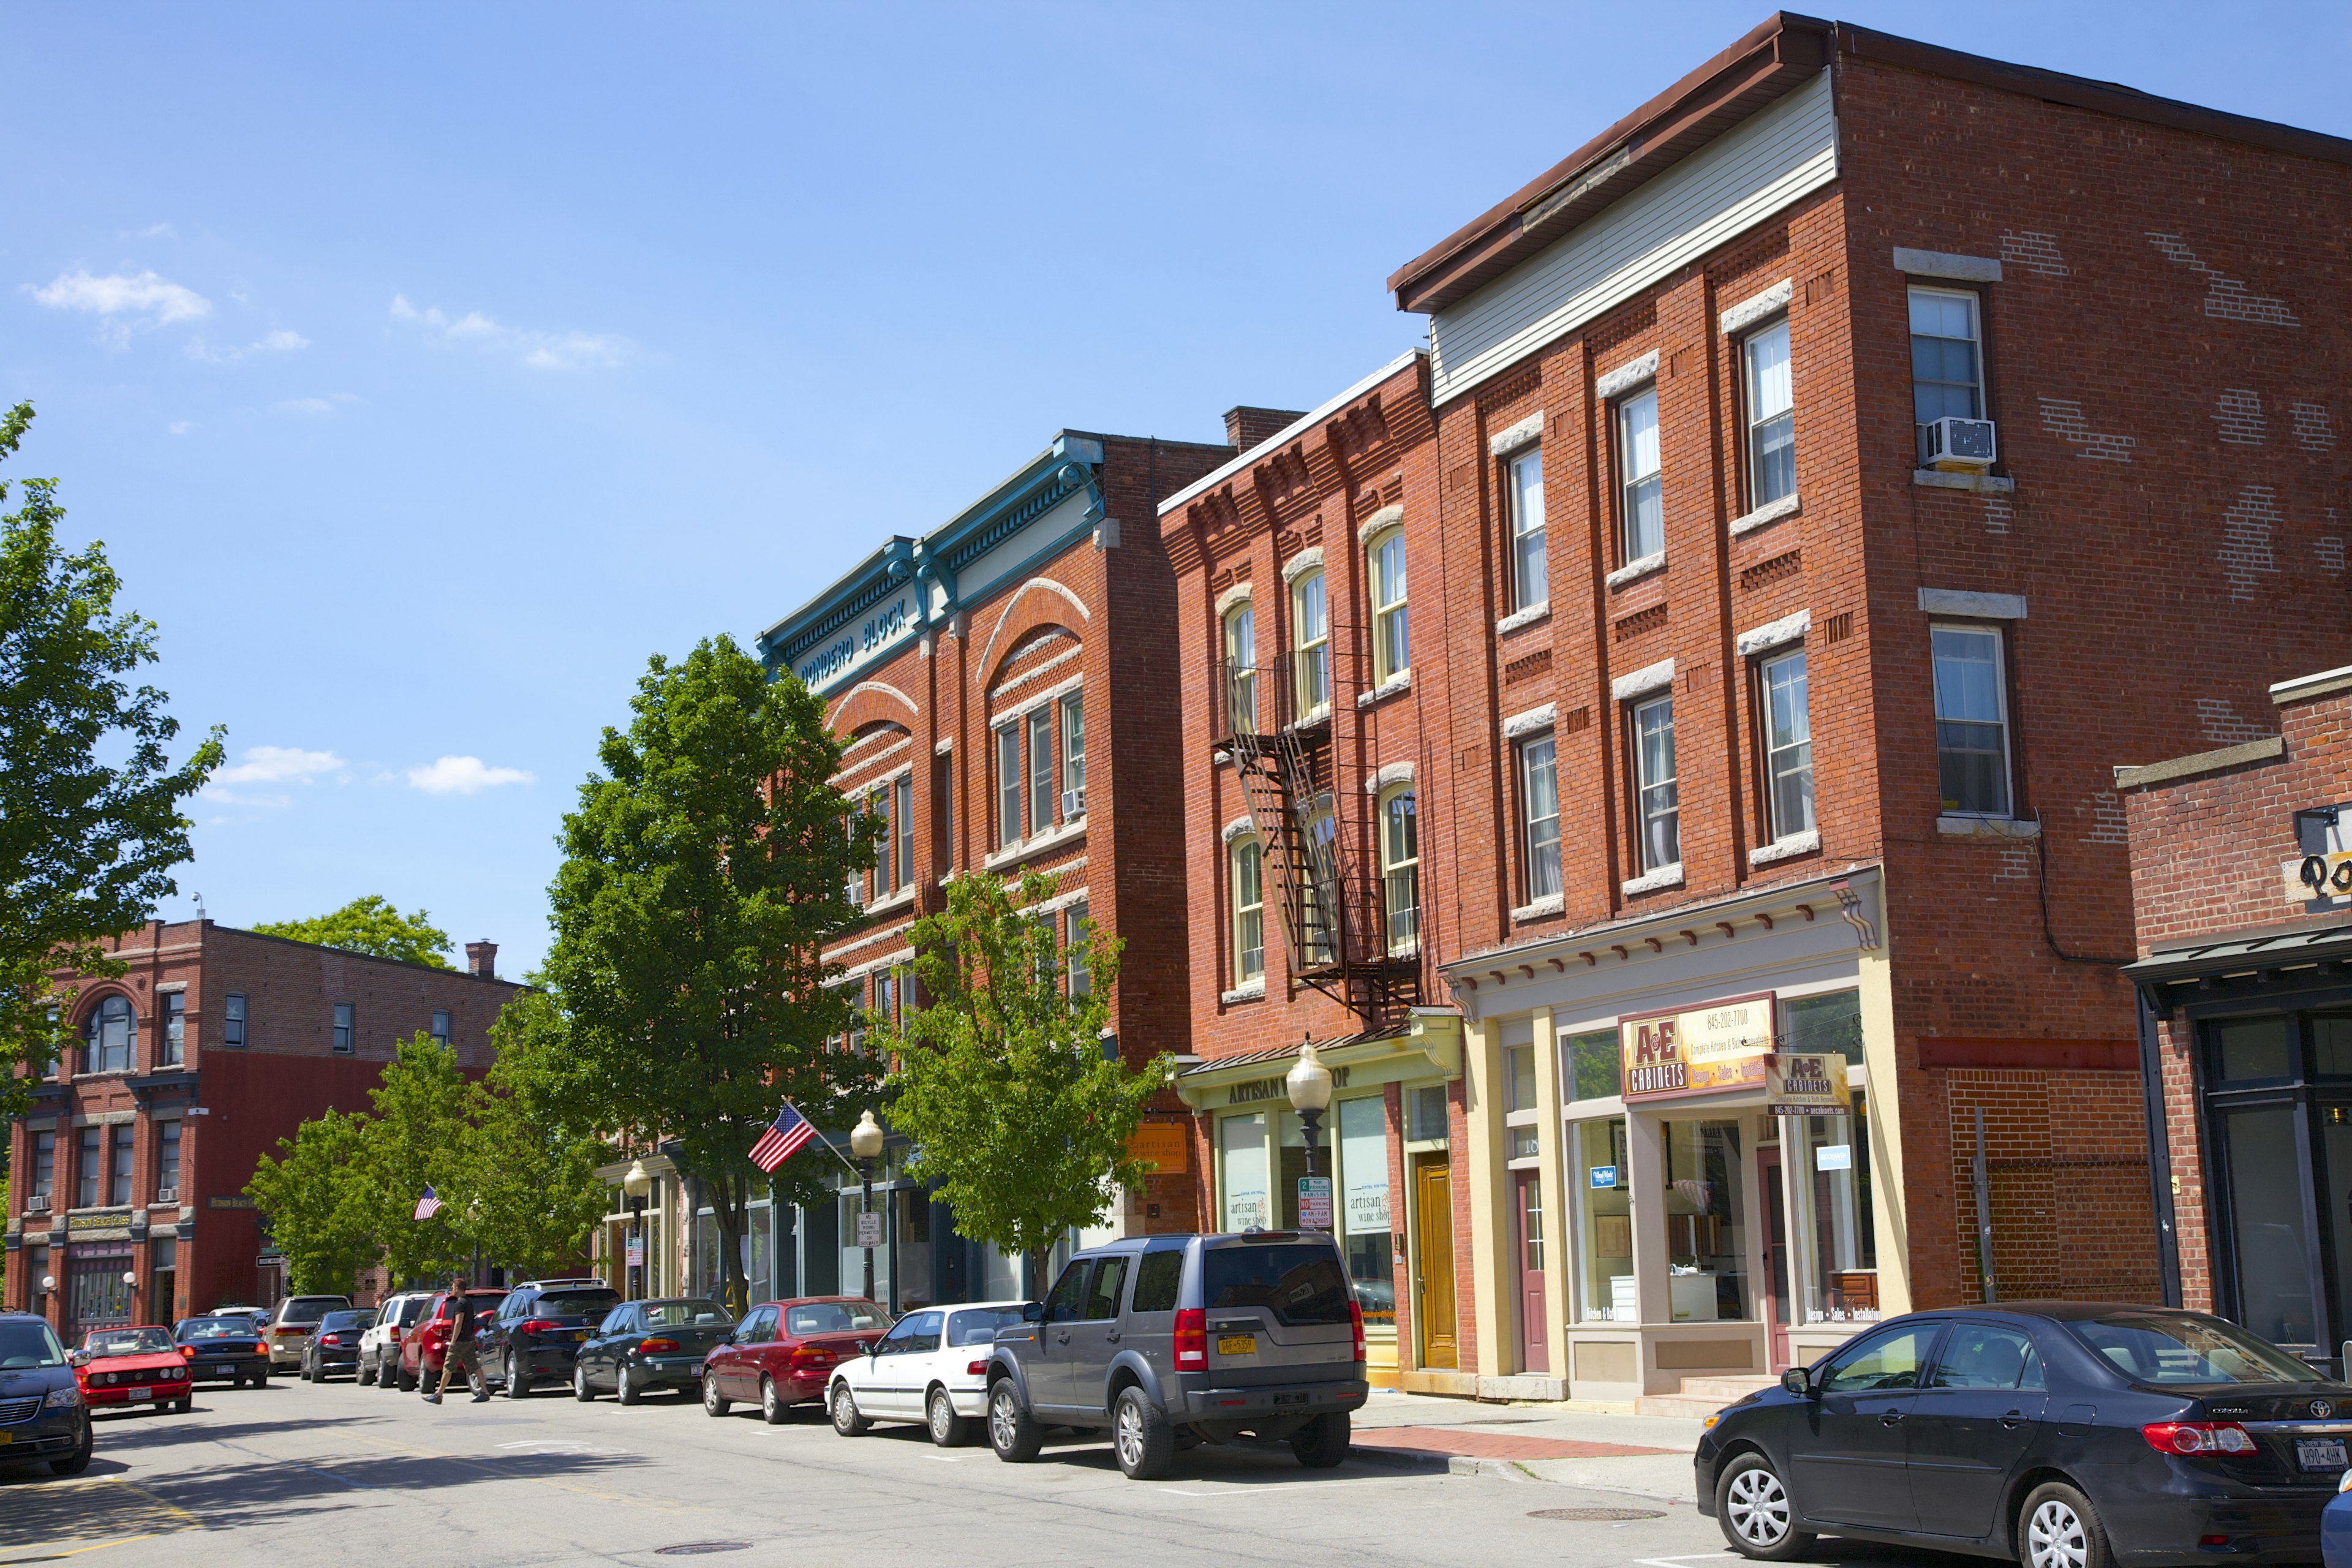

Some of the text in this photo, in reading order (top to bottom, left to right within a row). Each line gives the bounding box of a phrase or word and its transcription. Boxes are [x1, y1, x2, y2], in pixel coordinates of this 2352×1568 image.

[800, 598, 905, 687] DONDERO BLOCK
[1708, 1009, 1748, 1030] 845-202-7700
[1635, 1019, 1677, 1066] A&E
[1691, 1043, 1710, 1056] Complete
[1711, 1040, 1727, 1052] Kitchen
[1727, 1038, 1731, 1050] &
[1692, 1068, 1709, 1085] Design
[1717, 1065, 1733, 1080] Sales
[1791, 1058, 1823, 1078] A&E
[1331, 1066, 1350, 1089] OP
[1632, 1063, 1684, 1091] CABINETS
[1229, 1078, 1279, 1104] ARTISAN
[1787, 1080, 1828, 1092] CABINETS
[1774, 1106, 1844, 1115] 845-202-7700 aecabinets.com
[1139, 1139, 1180, 1148] artisan
[1162, 1148, 1181, 1159] shop
[1302, 1181, 1306, 1189] 2
[1231, 1197, 1257, 1214] artisan
[1351, 1192, 1381, 1209] artisan
[70, 1214, 129, 1229] HUDSON BEACH GLASS
[1237, 1213, 1267, 1227] wine shop
[1358, 1208, 1374, 1223] wine
[1586, 1306, 1602, 1321] Kitchen
[1602, 1306, 1606, 1320] &
[1806, 1307, 1880, 1323] Design Sales Installation
